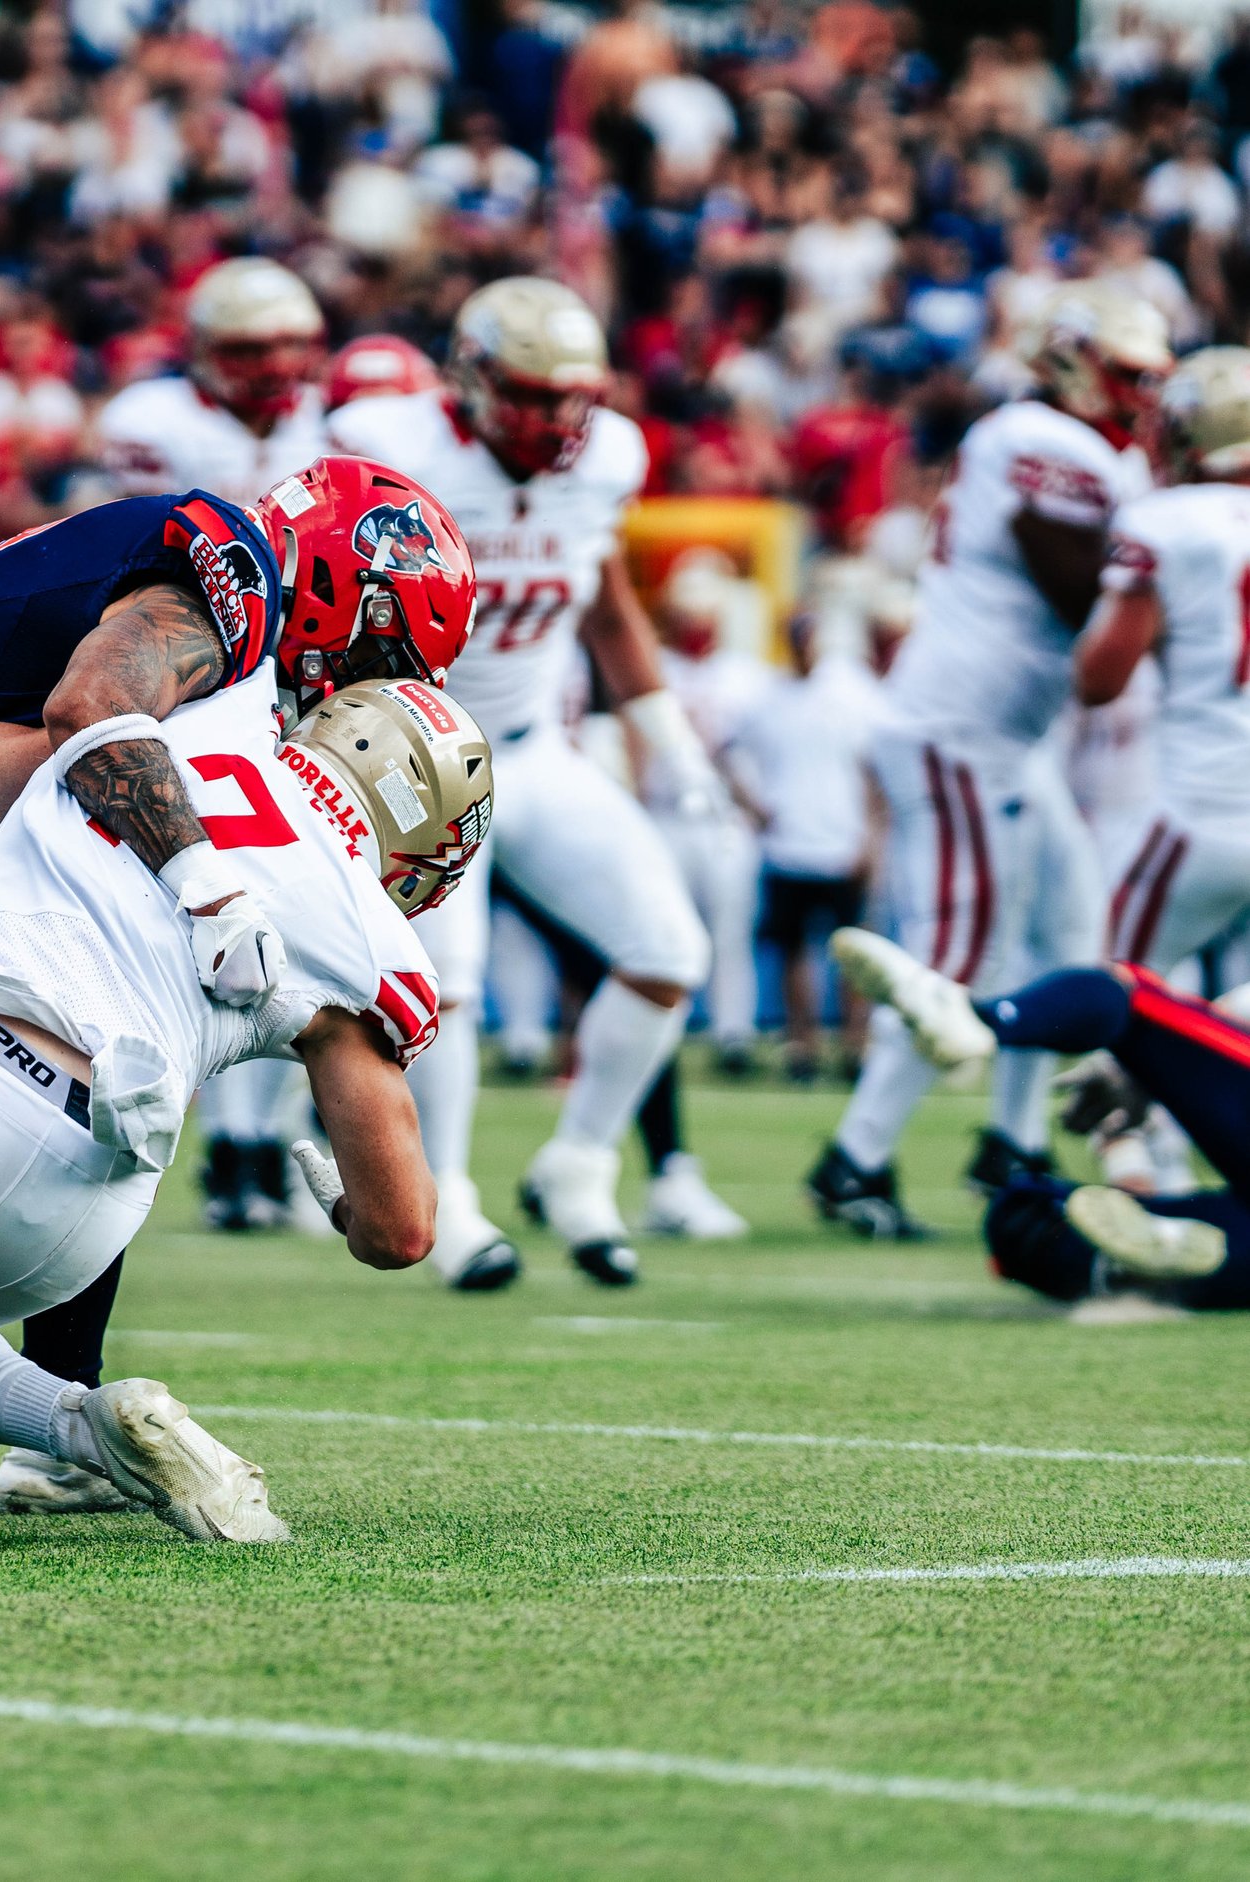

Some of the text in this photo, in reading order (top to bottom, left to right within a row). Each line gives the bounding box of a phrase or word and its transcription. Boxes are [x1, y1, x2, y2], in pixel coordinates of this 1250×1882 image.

[192, 552, 236, 638] HOUSE
[194, 537, 245, 633] BLOCK
[380, 687, 435, 746] Wir sind Matratze.
[405, 684, 450, 730] bett1.de
[277, 744, 369, 844] FORELLE
